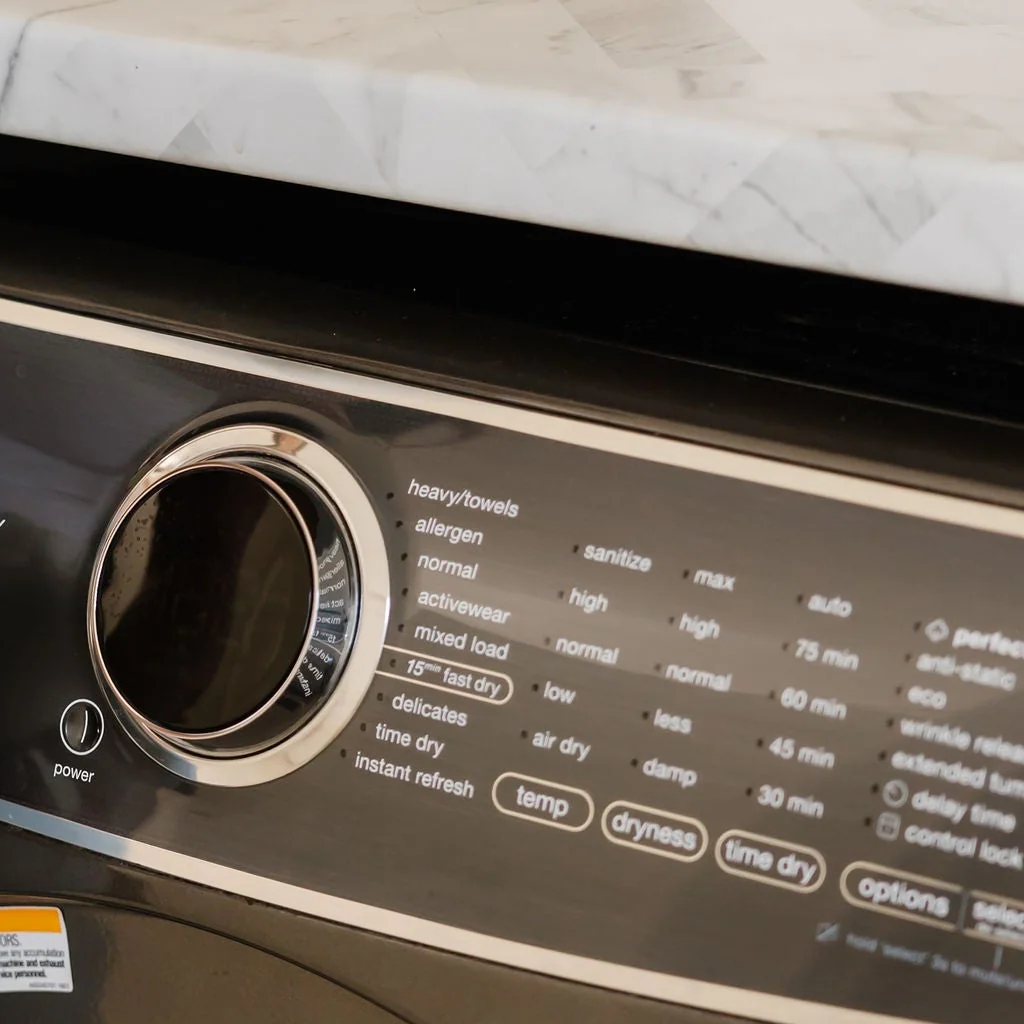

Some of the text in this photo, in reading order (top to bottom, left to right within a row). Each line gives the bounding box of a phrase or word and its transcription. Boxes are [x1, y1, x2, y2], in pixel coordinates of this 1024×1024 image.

[407, 478, 520, 518] heavy/towels
[415, 517, 484, 545] allergen
[417, 554, 479, 580] normal
[583, 544, 652, 573] sanitize
[693, 568, 736, 592] max
[417, 591, 512, 625] activewear
[568, 586, 609, 614] high
[807, 594, 853, 618] auto
[414, 625, 510, 660] mixed load
[678, 612, 721, 641] high
[555, 637, 620, 665] normal
[795, 637, 860, 671] 75 min
[443, 668, 473, 690] fast
[474, 677, 501, 699] dry
[665, 663, 732, 692] normal
[916, 653, 1017, 692] anti-static
[543, 680, 576, 705] low
[780, 687, 847, 720] 60 min
[907, 685, 947, 710] eco
[392, 693, 468, 727] delicates
[653, 708, 692, 734] less
[375, 722, 445, 759] time dry
[532, 731, 592, 762] air dry
[900, 718, 971, 751] wrinkle
[769, 736, 835, 769] 45 min
[53, 762, 95, 783] power
[354, 751, 475, 799] instant refresh
[642, 757, 698, 789] damp
[891, 751, 987, 789] extended
[516, 785, 569, 819] temp
[757, 784, 824, 819] 30 min
[911, 789, 1017, 834] delay time
[611, 811, 697, 851] dryness
[904, 825, 977, 859] control
[725, 839, 817, 885] time dry
[858, 877, 951, 918] options
